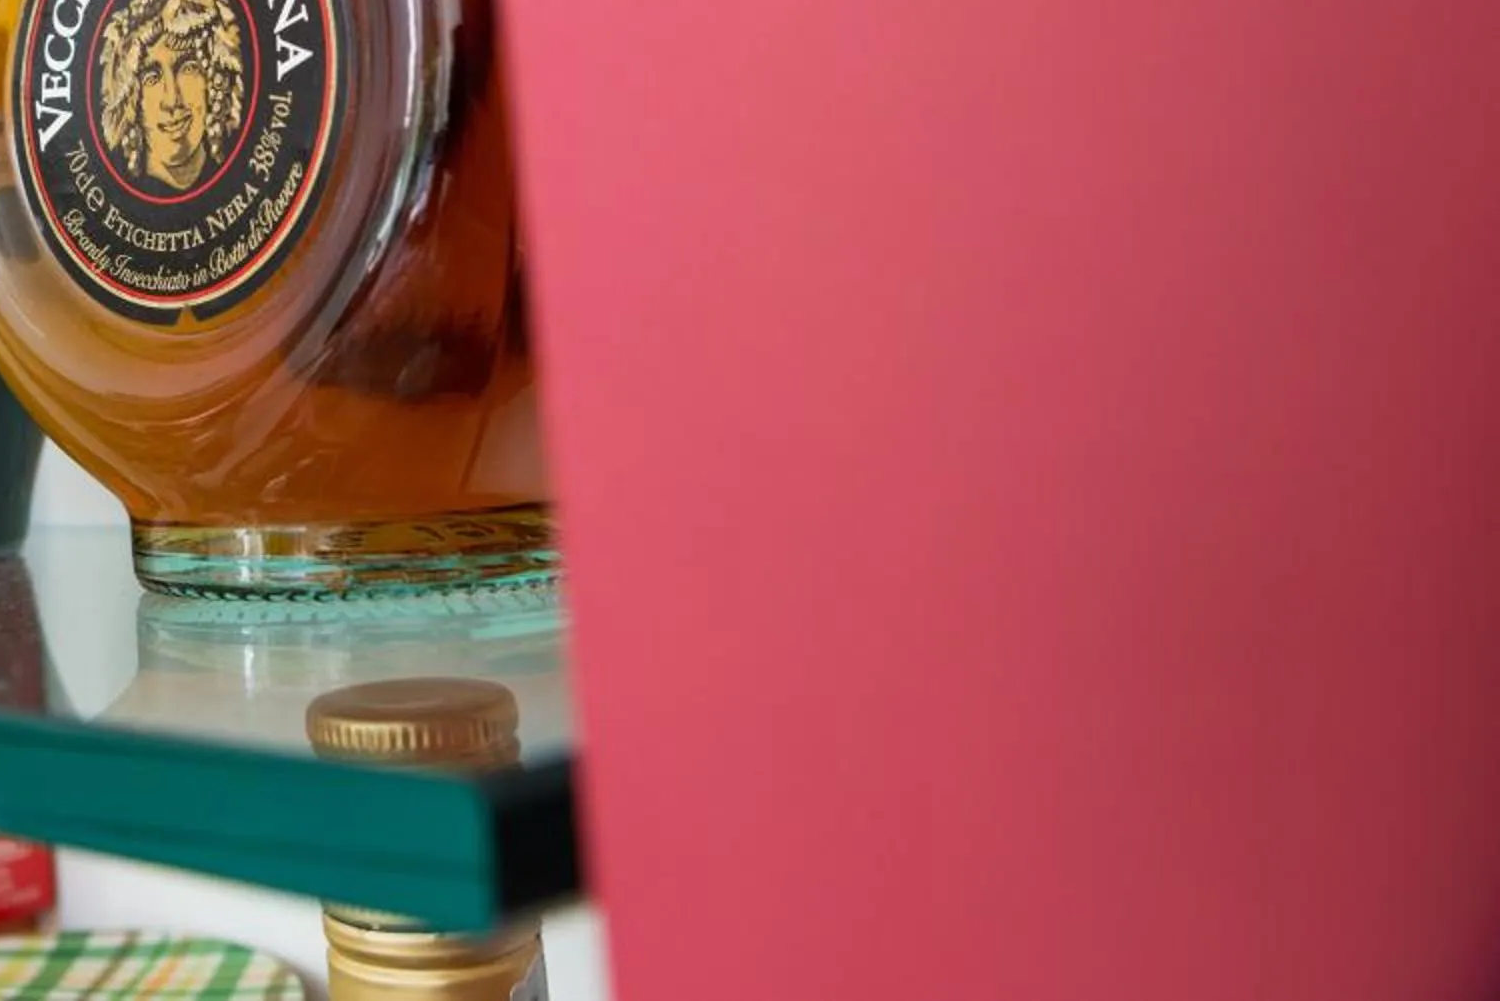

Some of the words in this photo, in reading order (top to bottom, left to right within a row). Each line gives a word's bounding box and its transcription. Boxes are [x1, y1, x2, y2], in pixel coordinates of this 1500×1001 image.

[104, 203, 205, 252] ETICHETTA
[206, 182, 259, 238] NERA
[249, 127, 282, 182] 38%
[193, 263, 208, 286] in
